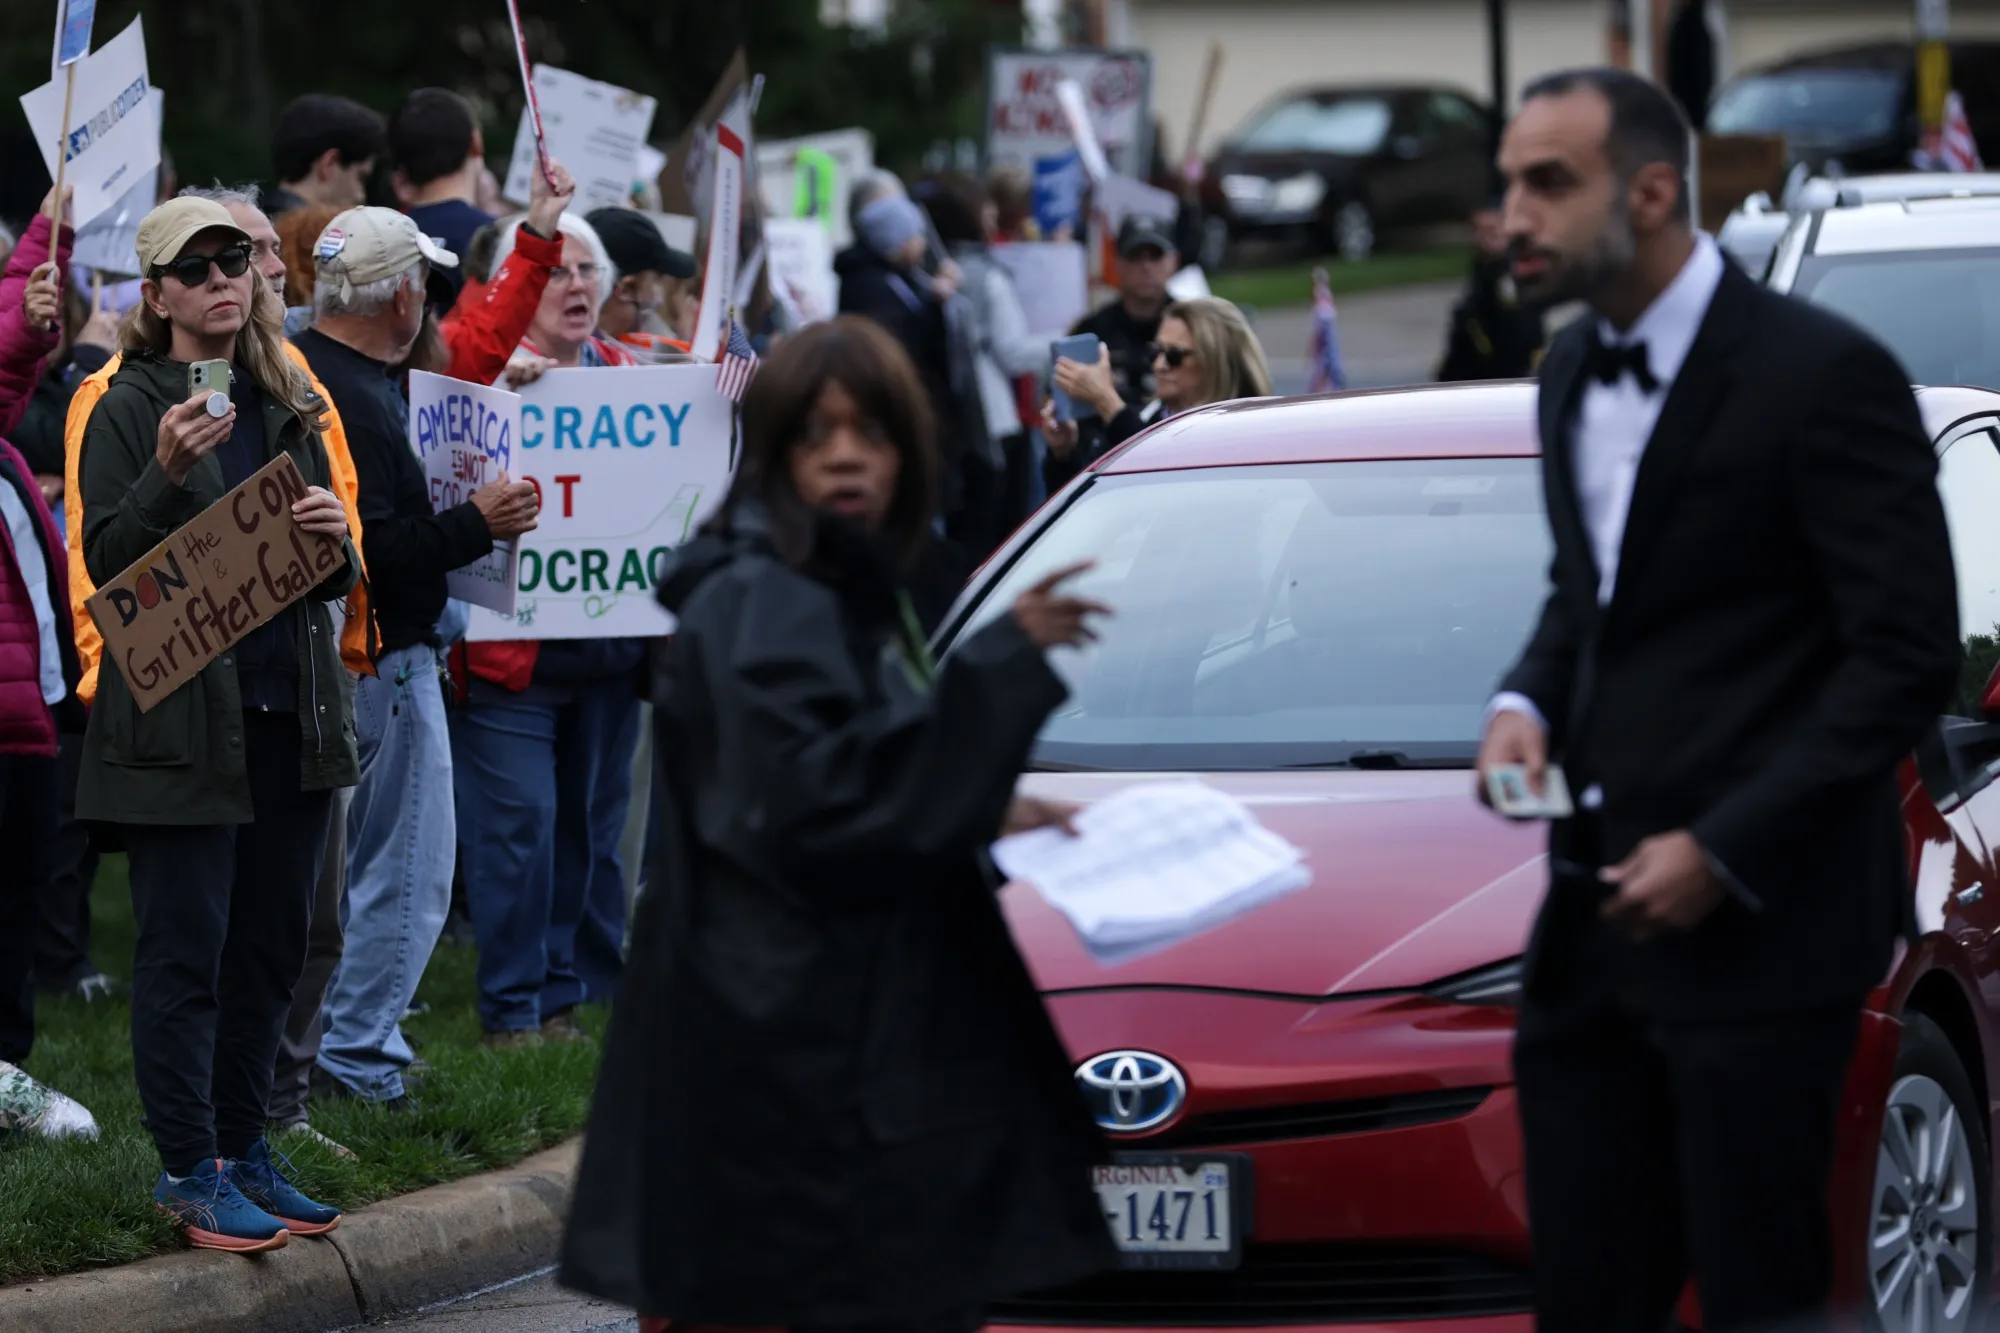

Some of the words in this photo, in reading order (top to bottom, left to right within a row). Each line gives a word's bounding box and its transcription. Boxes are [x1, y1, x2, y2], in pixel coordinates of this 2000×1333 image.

[417, 395, 511, 471] AMERICA
[521, 403, 692, 449] CRACY
[451, 449, 463, 469] IS
[463, 453, 488, 485] NOT
[105, 549, 188, 628] DON
[184, 530, 222, 564] the
[232, 462, 307, 535] CON
[126, 574, 260, 691] Grifter
[257, 526, 337, 603] Gala
[1096, 1165, 1179, 1185] RGINIA
